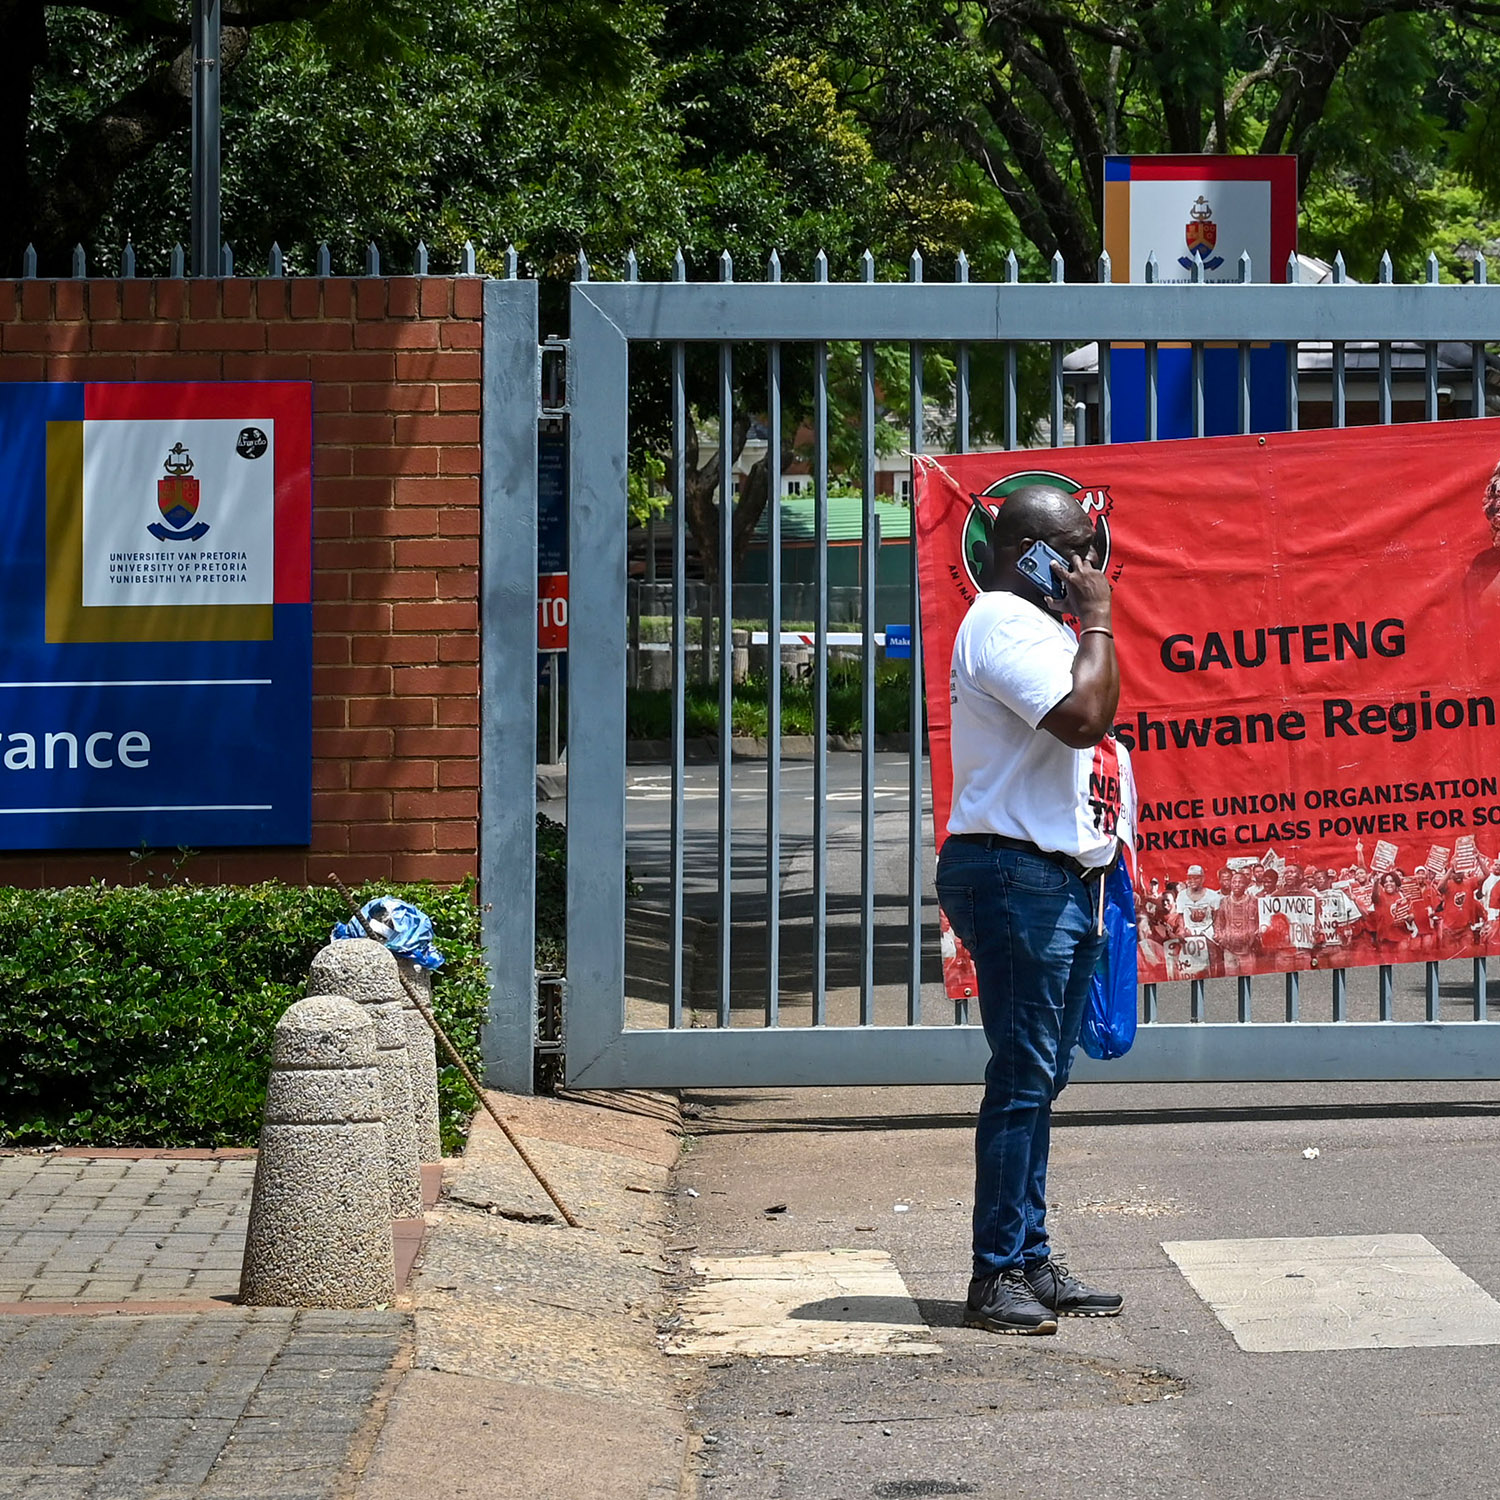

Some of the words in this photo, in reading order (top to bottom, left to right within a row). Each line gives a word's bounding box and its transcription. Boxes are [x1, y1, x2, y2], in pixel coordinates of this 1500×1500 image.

[109, 552, 175, 561] UNIVERSITEIT
[178, 552, 197, 560] VAN
[200, 552, 247, 560] PRETORIA
[109, 563, 174, 572] UNIVERSITY
[177, 563, 190, 571] OF
[194, 563, 247, 571] PRETORIA
[109, 575, 176, 584] YUNIBESITHI
[180, 575, 192, 583] YA
[196, 574, 247, 583] PRETORIA
[1111, 563, 1124, 583] ALL
[1160, 618, 1406, 673] GAUTENG
[1323, 691, 1496, 743] Region
[0, 731, 151, 770] ance
[1139, 799, 1204, 822] ANCE
[1212, 792, 1296, 816] UNION
[1304, 777, 1498, 809] ORGANISATION
[1234, 820, 1311, 844] CLASS
[1319, 813, 1409, 838] POWER
[1416, 808, 1467, 830] FOR
[1262, 898, 1281, 914] NO
[1285, 898, 1313, 916] MORE
